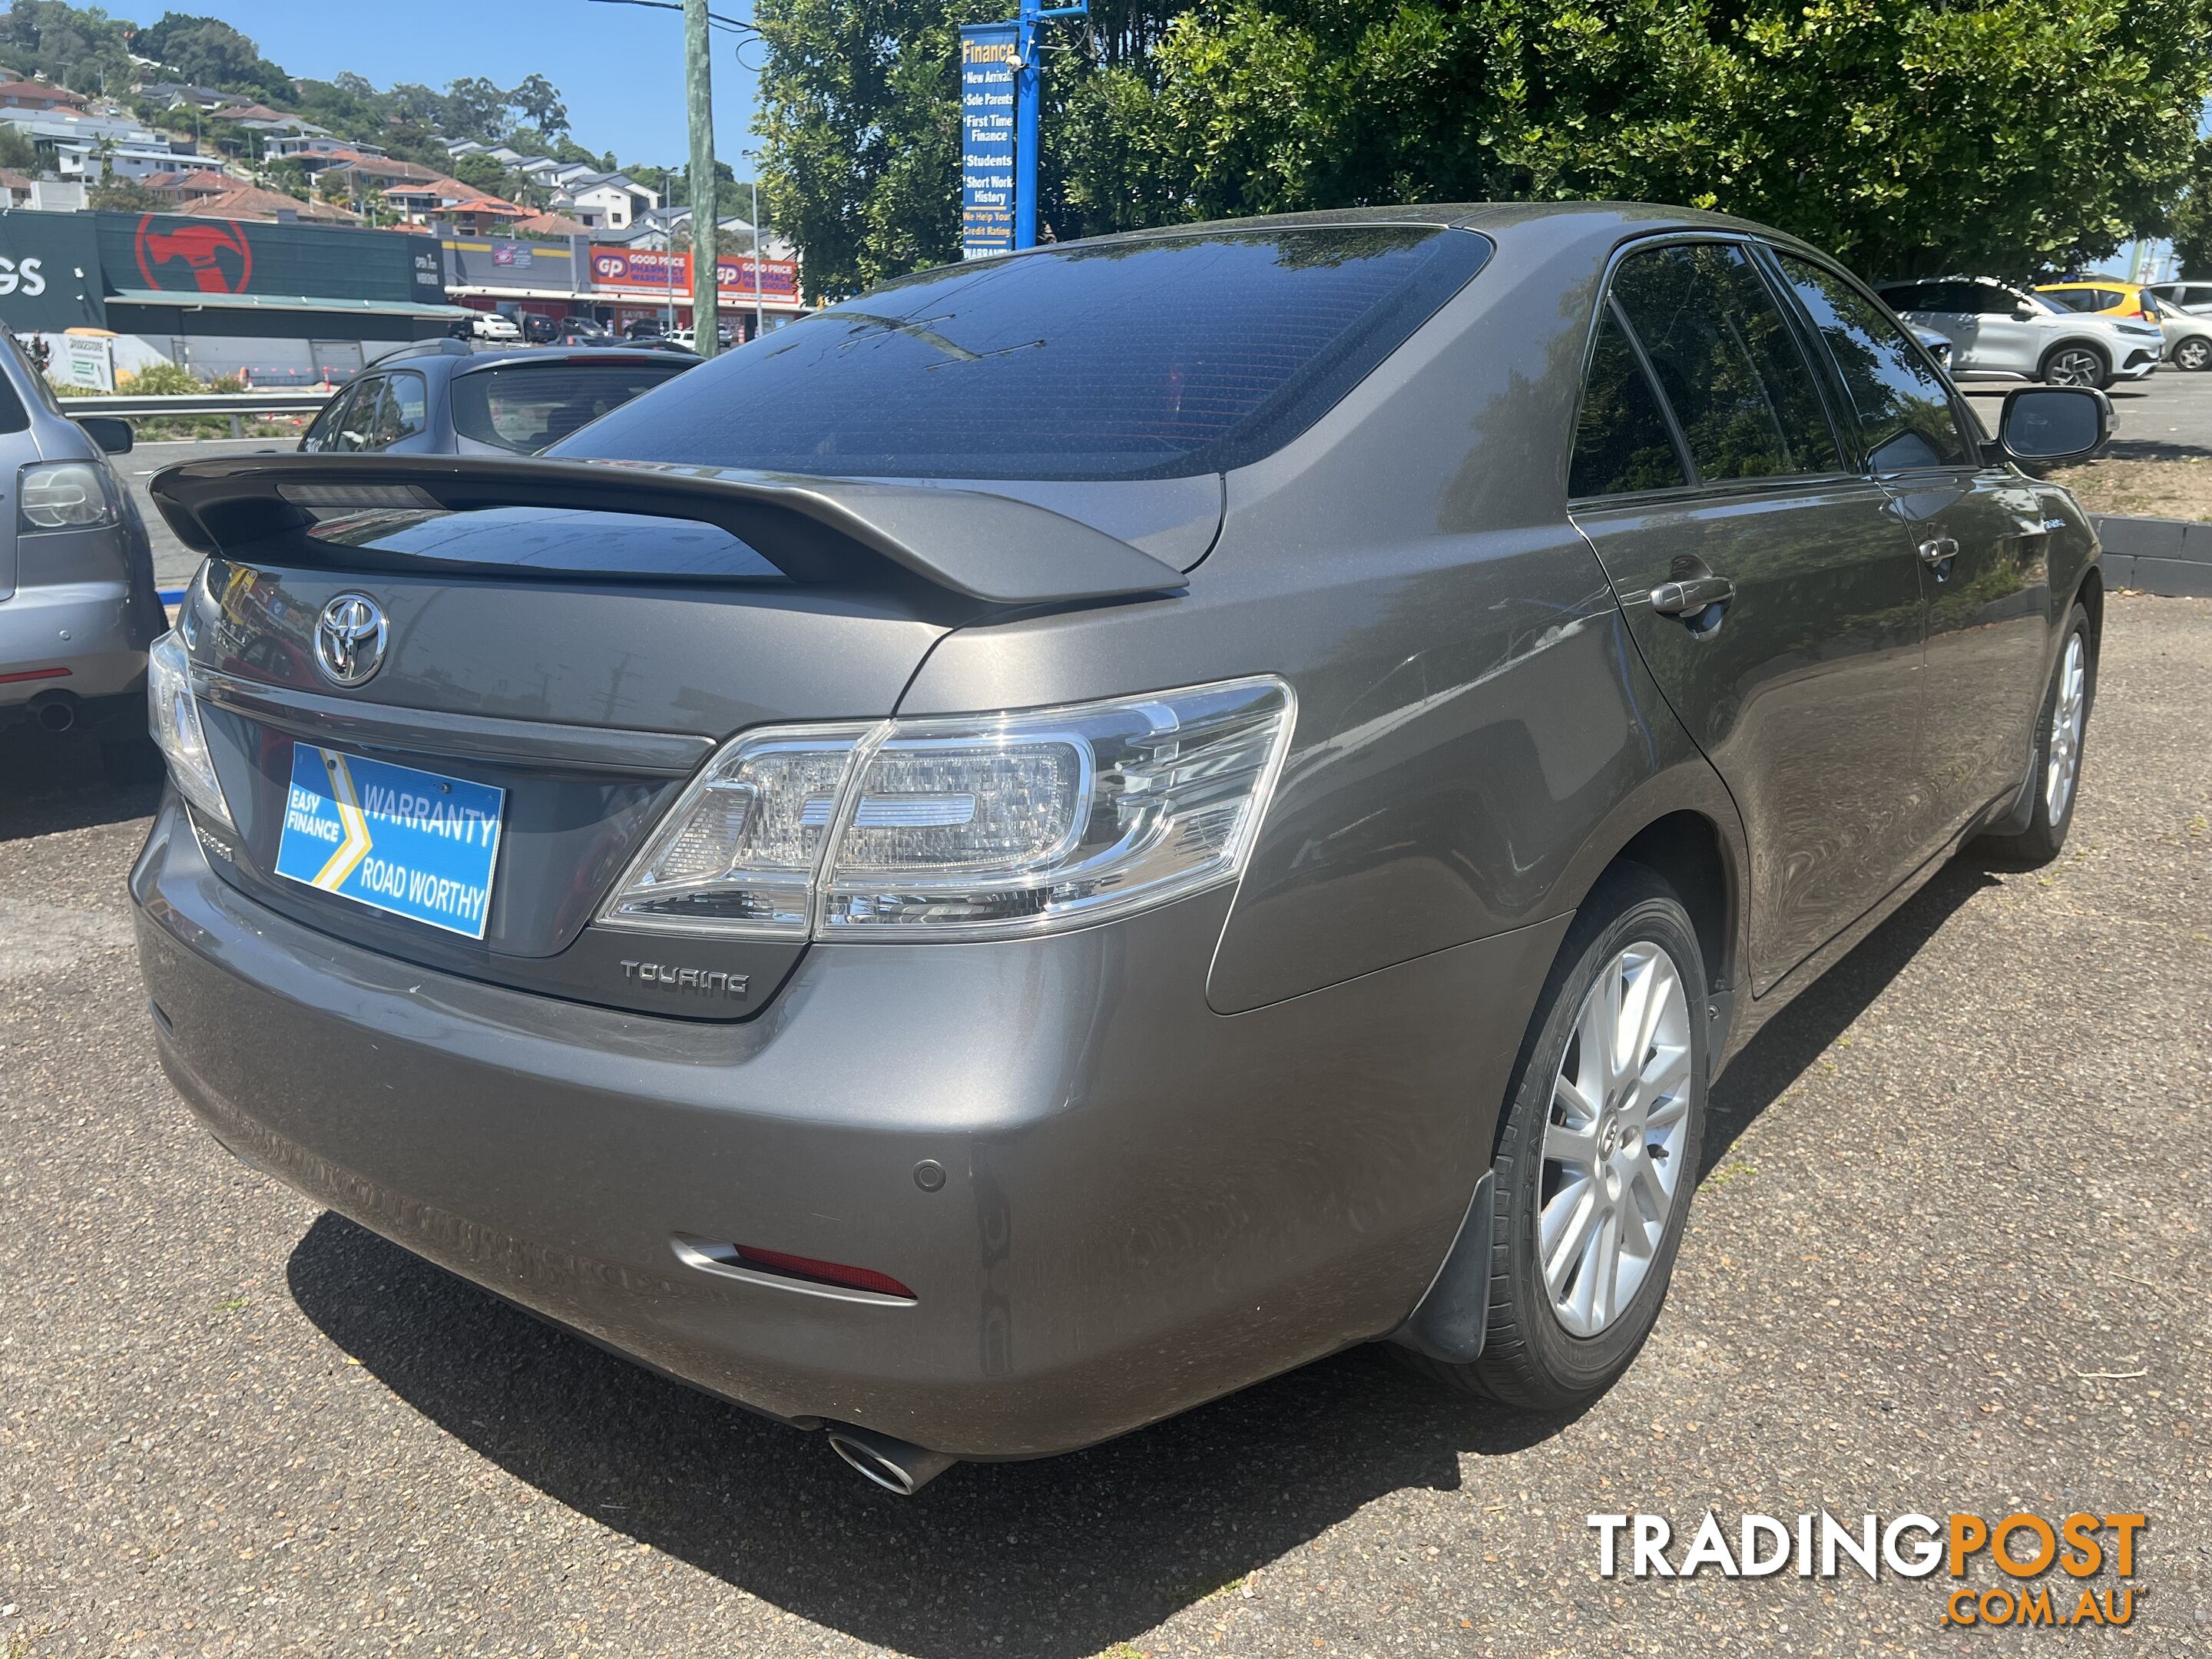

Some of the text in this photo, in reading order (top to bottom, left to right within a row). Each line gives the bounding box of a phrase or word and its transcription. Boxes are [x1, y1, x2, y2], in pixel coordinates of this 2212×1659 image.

[962, 40, 1015, 65] Finance
[967, 71, 984, 84] New
[966, 93, 1014, 106] Sole Parents
[966, 114, 1013, 127] First Time
[972, 129, 1008, 142] Finance
[966, 154, 1013, 167] Students
[966, 175, 1013, 188] Short Work
[974, 190, 1006, 206] History
[962, 212, 1012, 224] We Help Your
[962, 227, 1011, 238] Credit Rating
[629, 254, 657, 265] GOOD
[631, 263, 684, 275] PHARMCY
[742, 263, 792, 274] GOD PRICE
[631, 273, 684, 283] WAREHOSE
[743, 272, 791, 282] PHRMACY
[743, 282, 793, 290] WAEHOUSE
[290, 789, 320, 814] EASY
[364, 783, 496, 848] WARRANTY
[286, 813, 340, 843] FINANCE
[360, 857, 485, 922] ROAD WORTHY
[620, 960, 750, 993] TOURING
